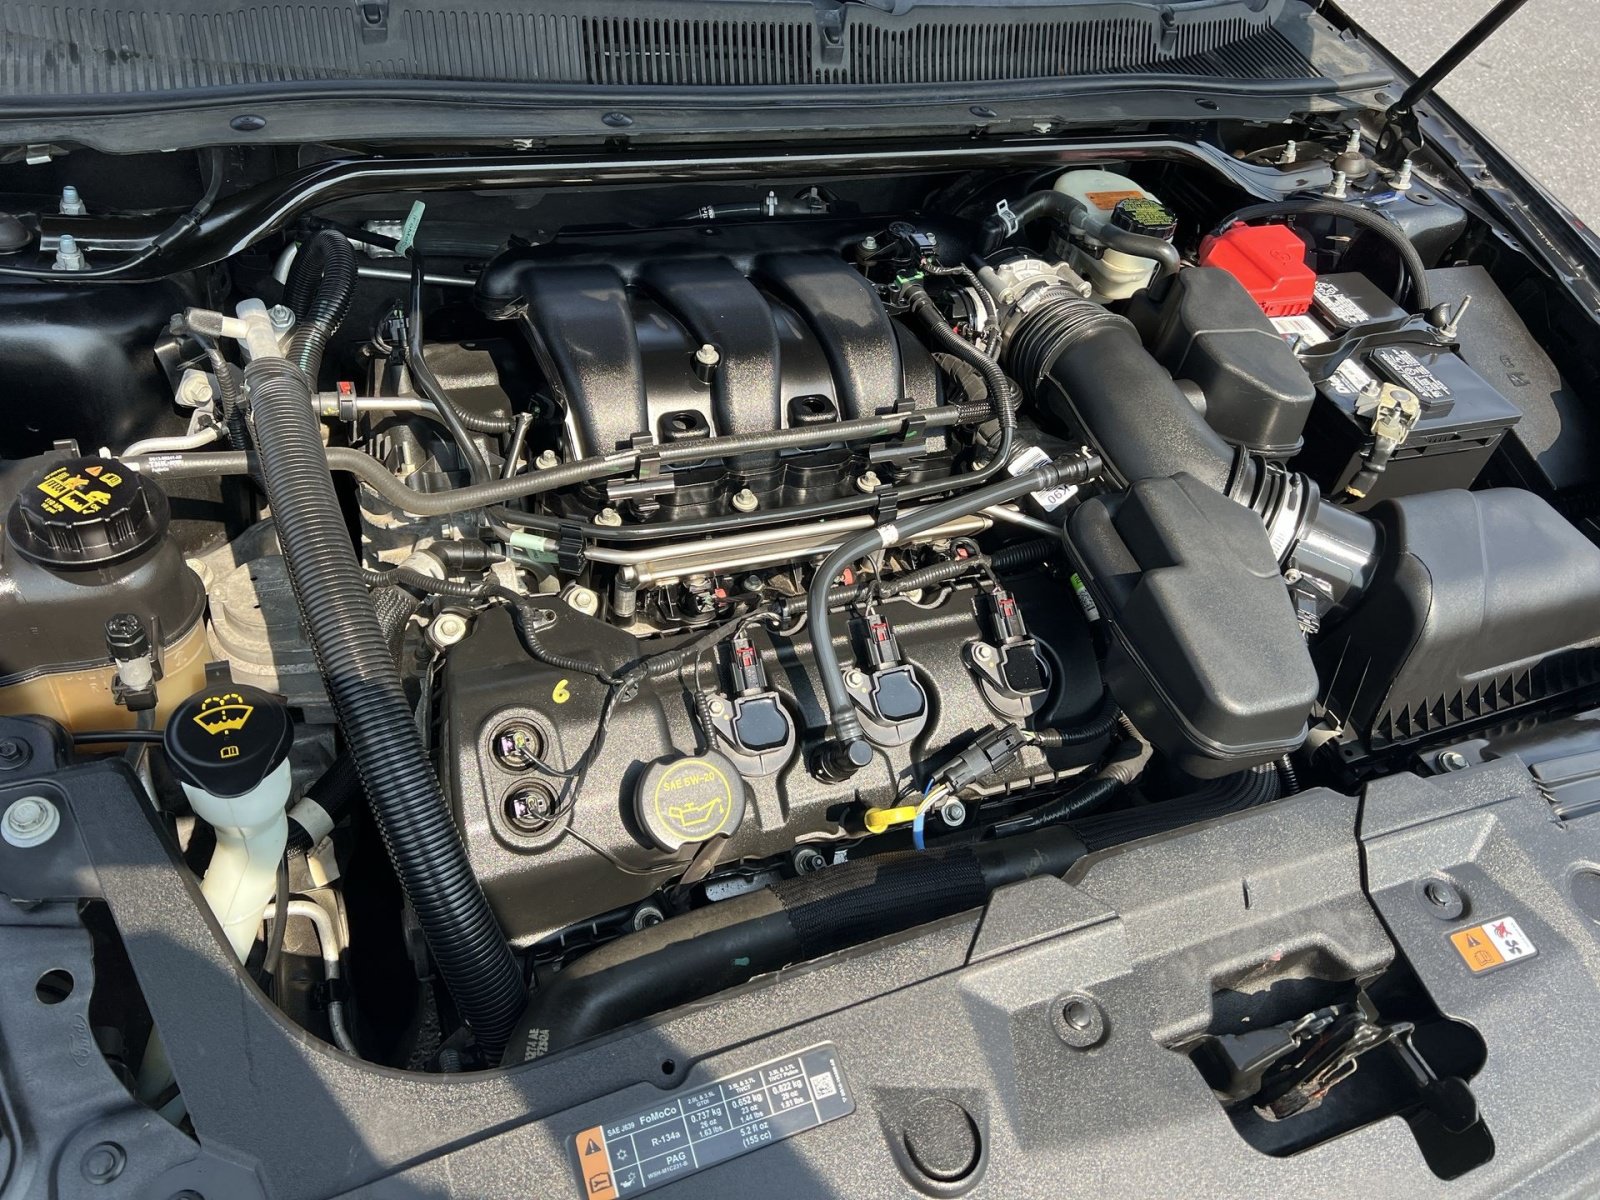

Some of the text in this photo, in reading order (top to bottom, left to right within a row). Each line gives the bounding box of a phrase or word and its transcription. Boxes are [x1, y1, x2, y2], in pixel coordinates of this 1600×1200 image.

[552, 679, 570, 704] 6
[663, 778, 682, 792] SAE
[772, 1079, 803, 1095] 0.822 kg
[732, 1094, 762, 1109] 0.652 kg
[794, 1096, 804, 1105] lbs
[640, 1107, 676, 1126] FoMoCo
[690, 1108, 722, 1123] 0.737 kg
[741, 1106, 750, 1114] 23
[700, 1120, 708, 1129] 26
[740, 1114, 754, 1124] 1.44
[607, 1122, 636, 1137] SAE J639
[700, 1126, 724, 1138] 1.63 lbs
[740, 1126, 752, 1136] 5.2
[759, 1122, 768, 1130] oz
[652, 1132, 680, 1147] R-134a
[742, 1130, 772, 1148] (155 cc)
[666, 1152, 686, 1165] PAG
